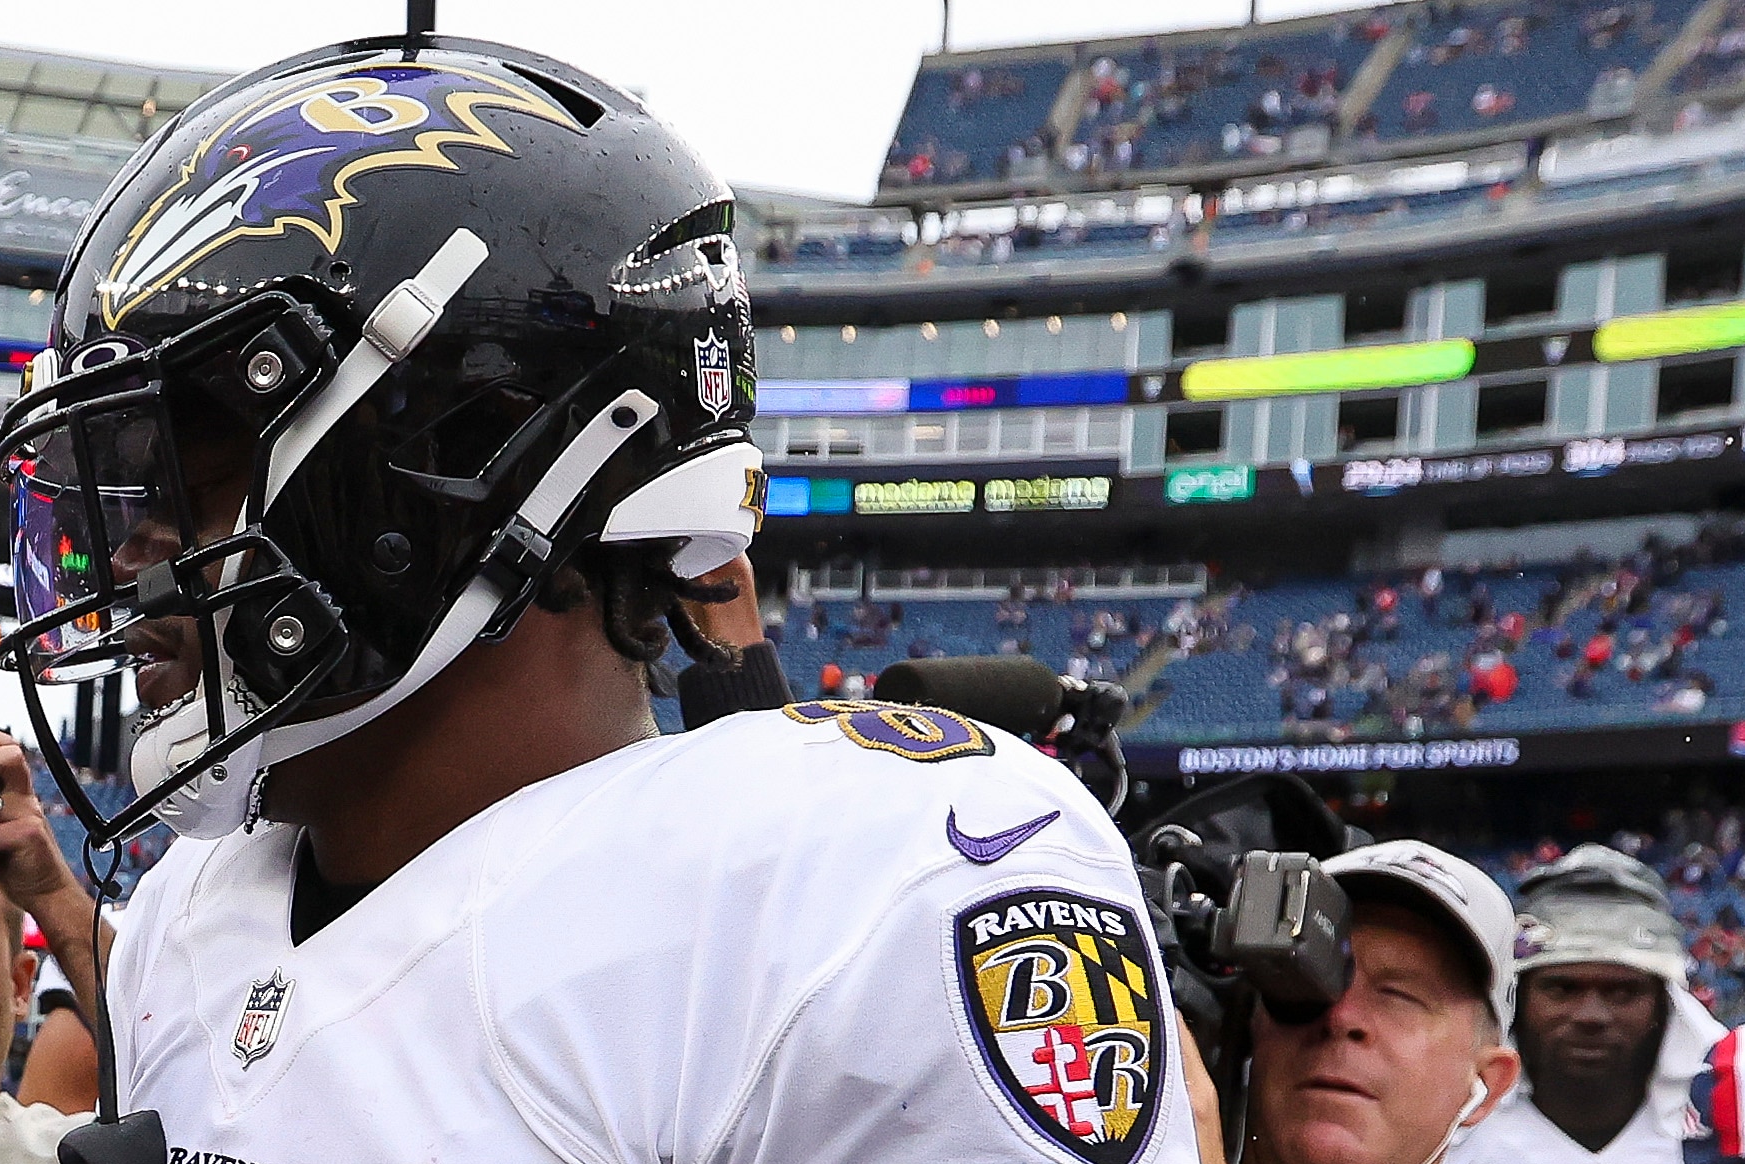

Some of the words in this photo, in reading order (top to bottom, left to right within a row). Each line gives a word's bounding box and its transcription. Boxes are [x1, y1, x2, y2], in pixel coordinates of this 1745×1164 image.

[703, 370, 728, 407] NFL
[968, 900, 1127, 947] RAVENS
[977, 939, 1073, 1028] B
[237, 1012, 271, 1049] NFL
